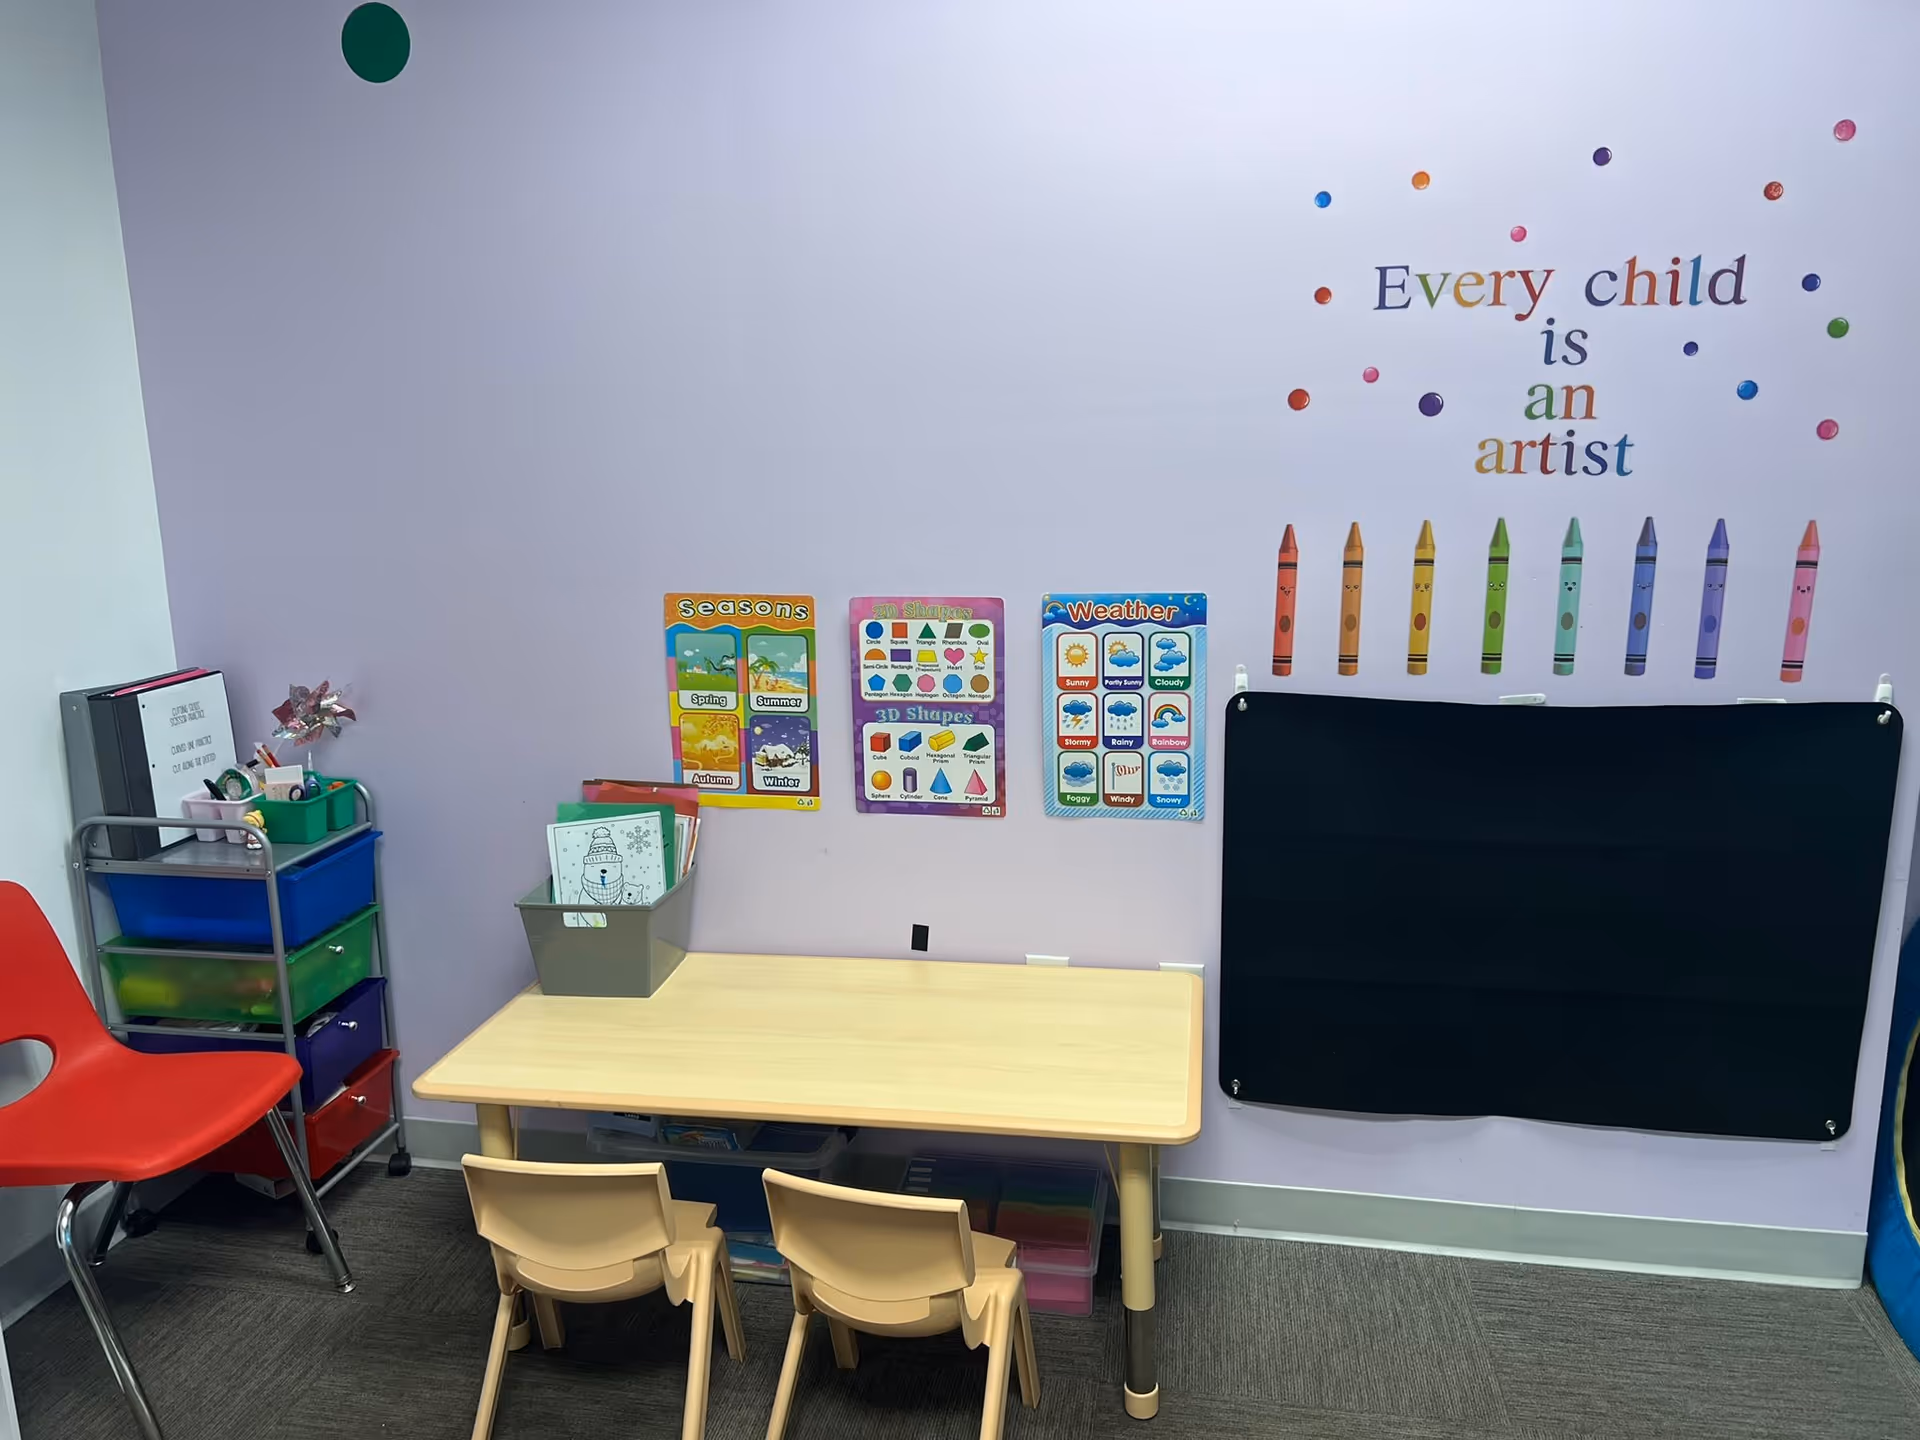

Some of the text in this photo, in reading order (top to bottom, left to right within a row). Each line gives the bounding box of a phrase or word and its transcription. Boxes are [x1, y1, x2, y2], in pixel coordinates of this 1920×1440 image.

[1373, 253, 1748, 321] Every child
[1541, 317, 1588, 365] is
[1524, 383, 1598, 420] an
[1474, 429, 1634, 476] artist
[678, 598, 809, 620] Seasons
[904, 600, 973, 622] Shapes
[1067, 600, 1180, 623] Weather
[1065, 679, 1090, 687] Sunny
[1105, 679, 1123, 687] Partly
[1155, 678, 1185, 687] Cloudy
[691, 694, 728, 706] Spring
[756, 696, 802, 707] Summer
[875, 705, 974, 726] 3D Shapes
[1065, 738, 1092, 747] Stormy
[1111, 738, 1134, 747] Rainy
[1152, 738, 1187, 746] Rainbow
[692, 773, 733, 785] Autumn
[763, 776, 800, 787] Winter
[1066, 794, 1090, 803] Foggy
[1110, 795, 1135, 803] Windy
[1156, 796, 1182, 804] Snowy
